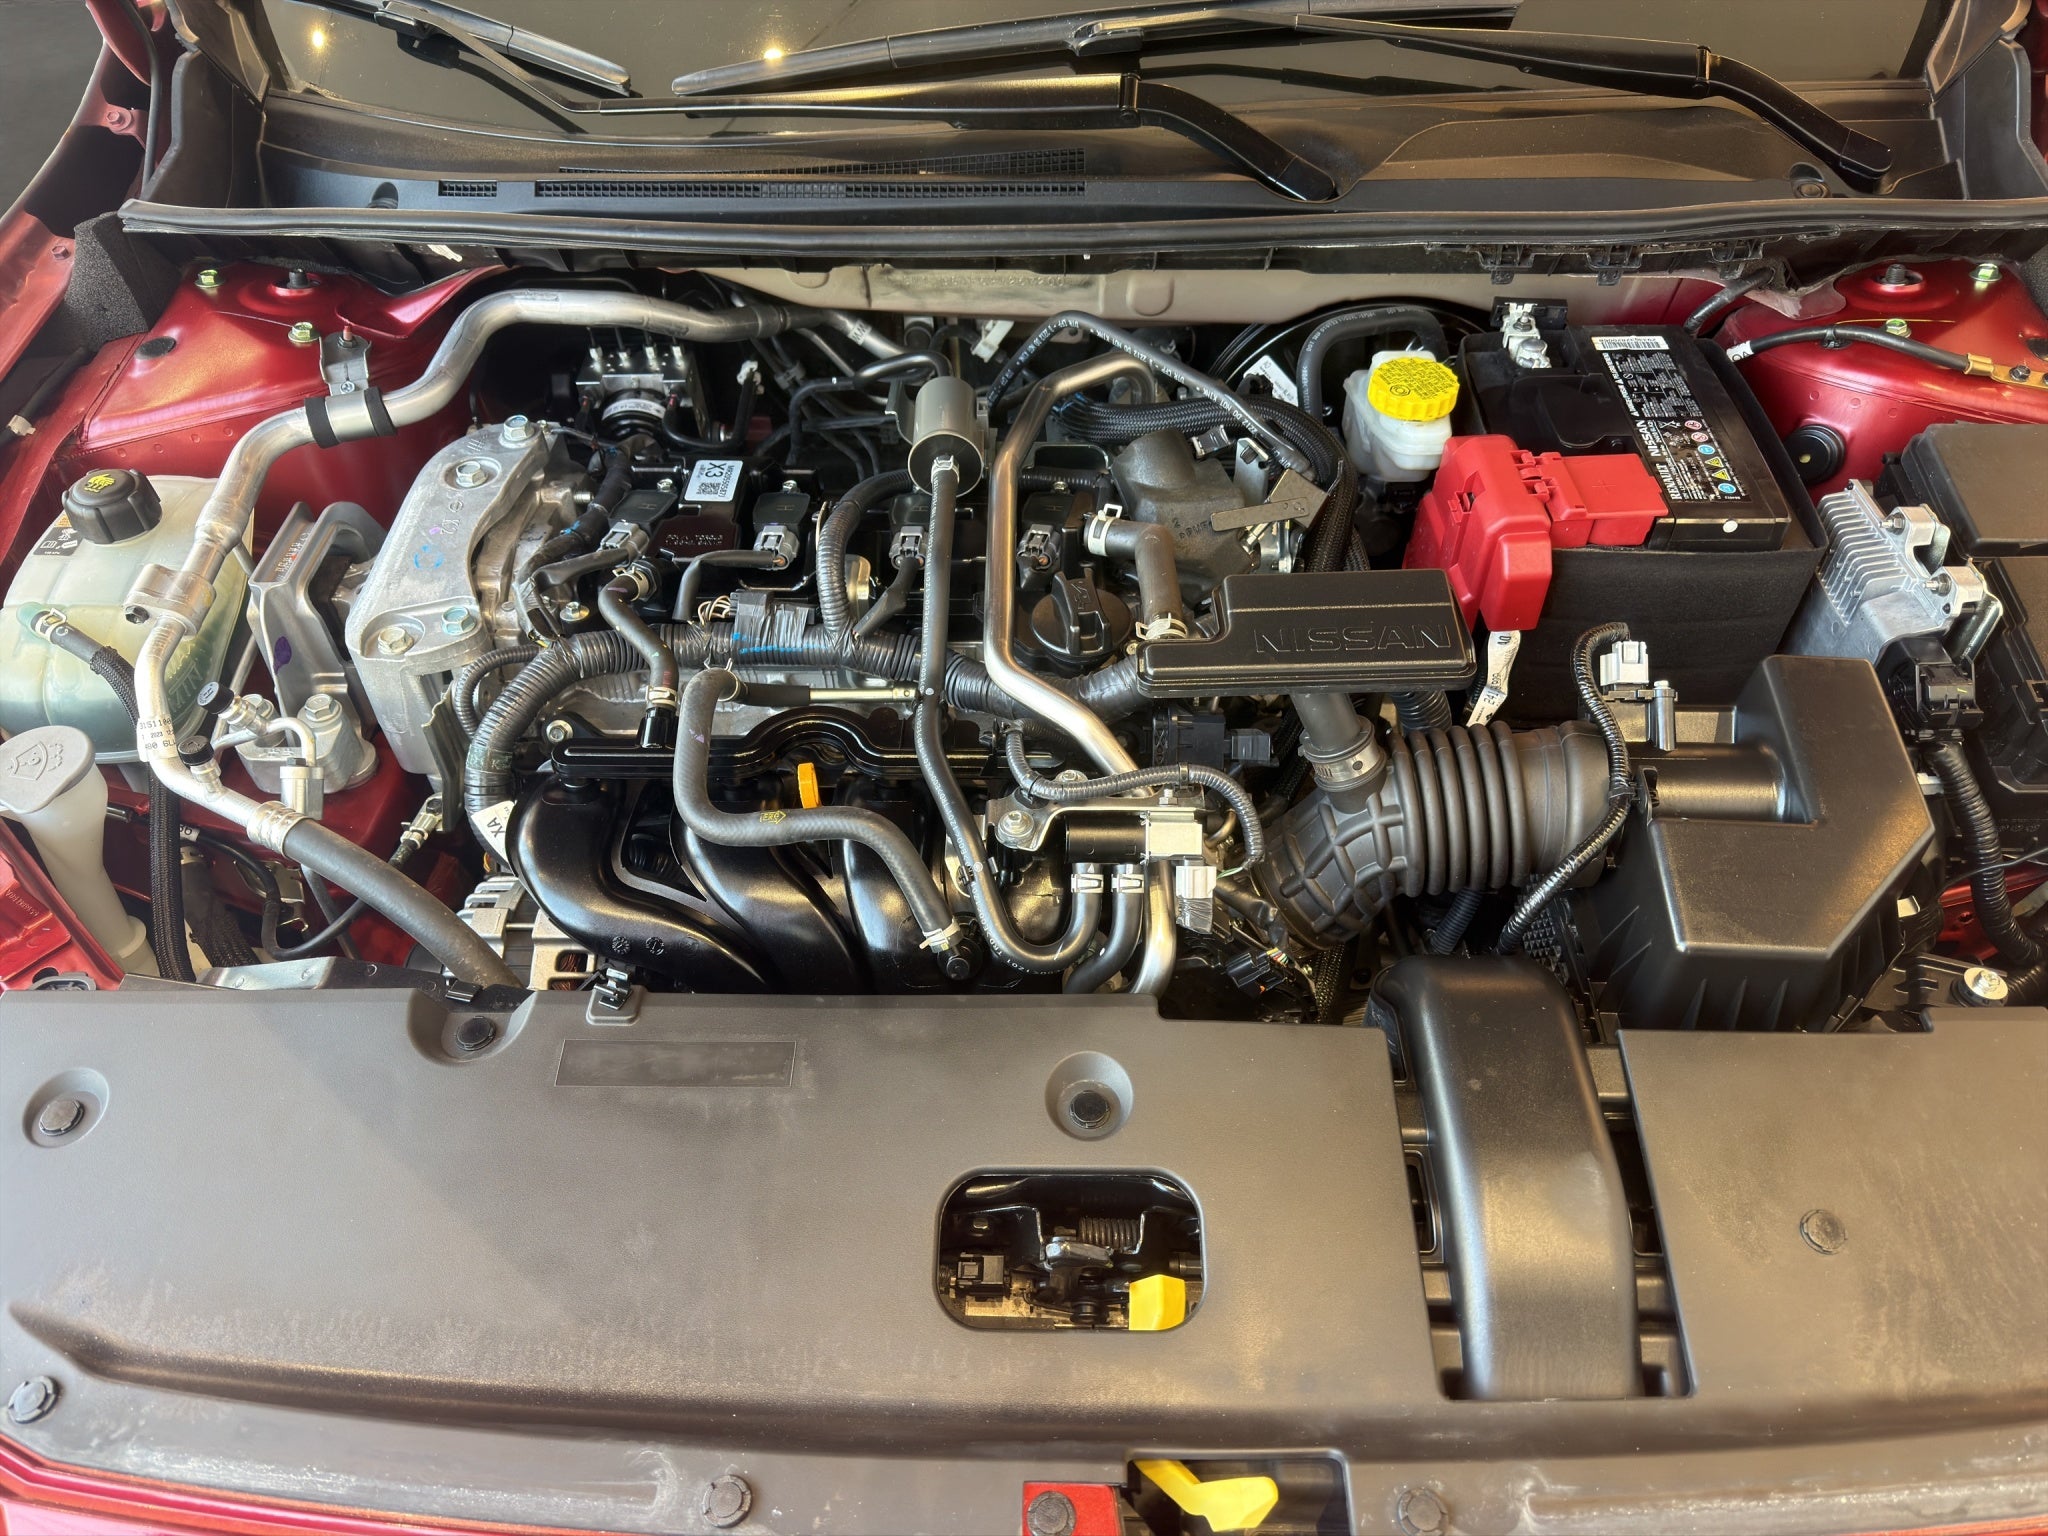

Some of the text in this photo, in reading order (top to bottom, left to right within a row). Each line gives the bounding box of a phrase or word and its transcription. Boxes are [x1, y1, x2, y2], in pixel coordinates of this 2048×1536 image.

[1094, 329, 1110, 342] KINK
[1109, 338, 1122, 349] NOT
[1121, 345, 1132, 355] DO
[1200, 388, 1217, 402] KINK
[1218, 399, 1231, 412] NOT
[1231, 410, 1241, 420] DO
[1633, 420, 1662, 456] NISSAN
[705, 462, 727, 478] X3
[1654, 463, 1683, 499] RENAULT
[1254, 624, 1451, 652] NISSAN
[487, 817, 505, 838] XA
